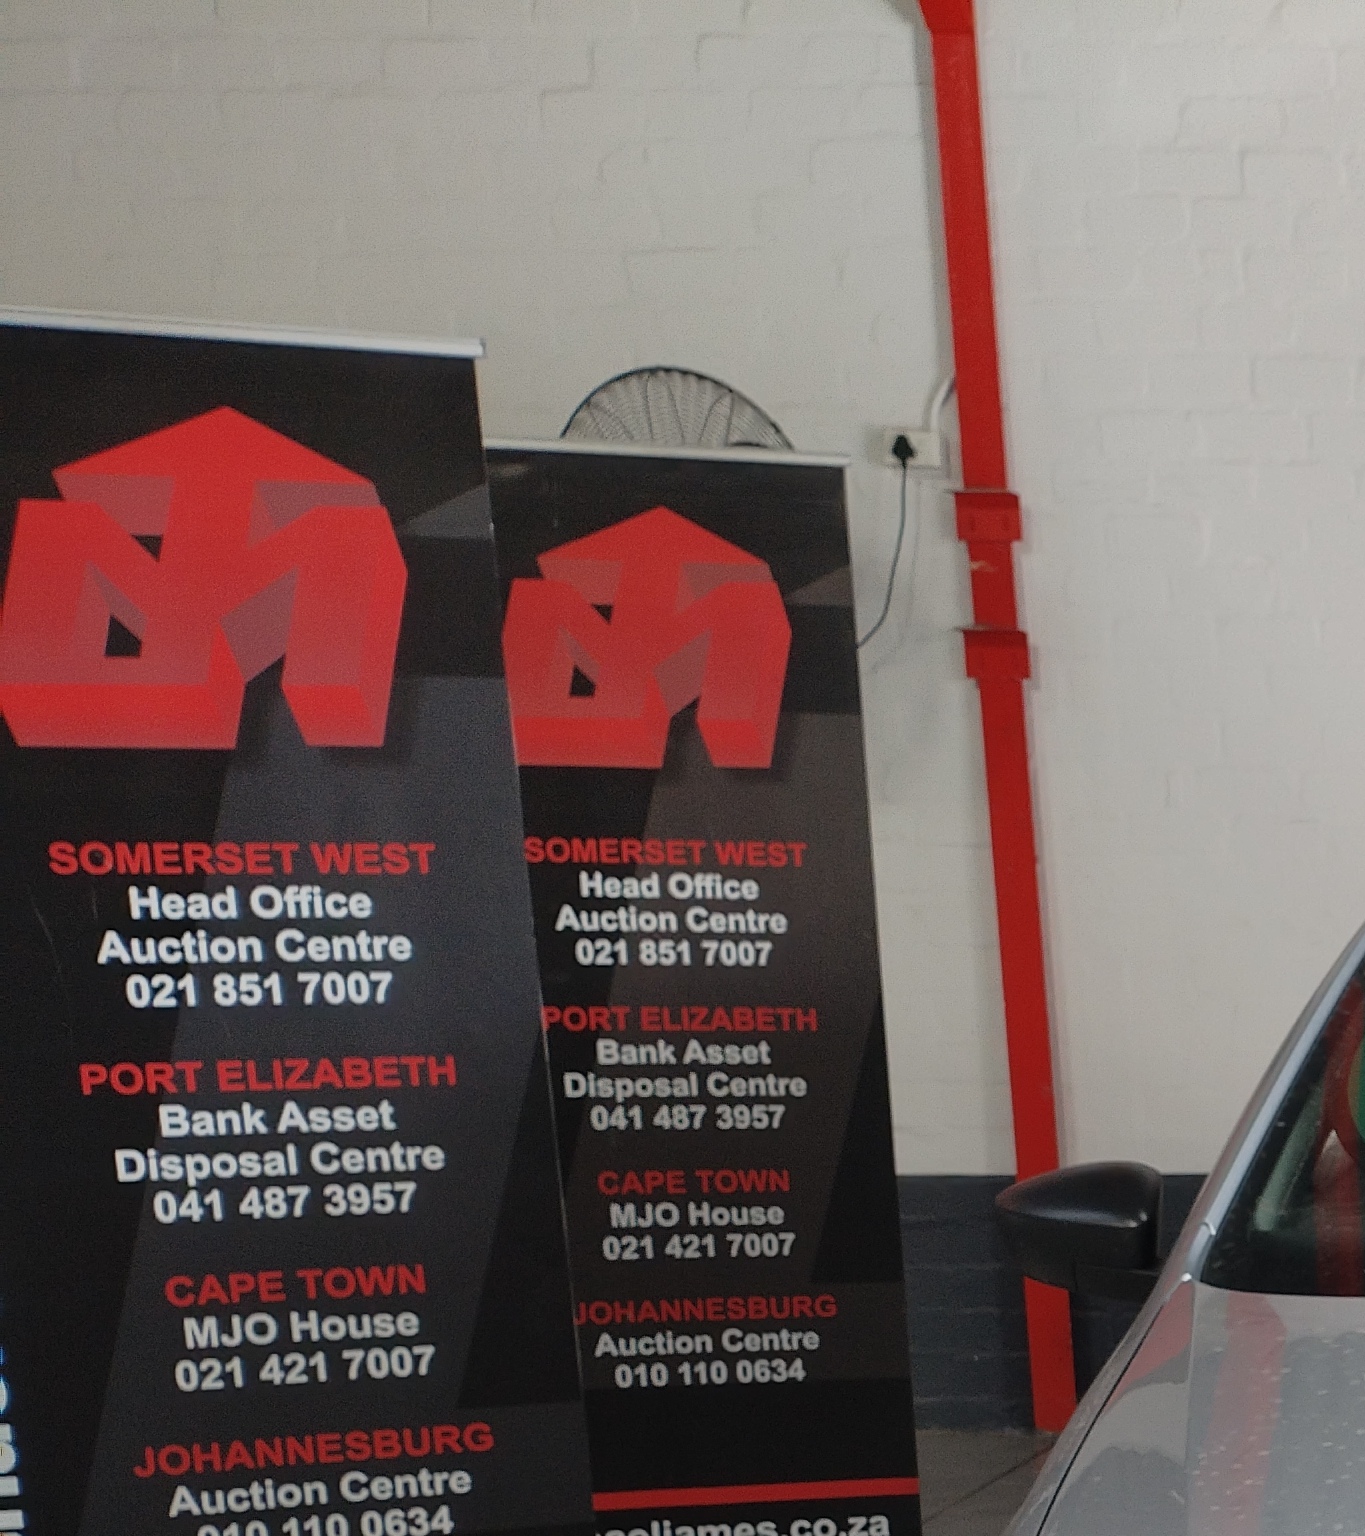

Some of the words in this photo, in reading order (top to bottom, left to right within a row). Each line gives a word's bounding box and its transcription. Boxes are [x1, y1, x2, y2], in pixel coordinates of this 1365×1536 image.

[48, 841, 298, 875] SOMERSET
[310, 843, 436, 874] WEST
[523, 837, 706, 865] SOMERSET
[715, 840, 808, 867] WEST
[579, 871, 659, 899] Head
[667, 873, 760, 900] Office
[129, 886, 237, 920] Head
[250, 887, 373, 919] Office
[555, 905, 678, 933] Auction
[685, 908, 788, 934] Centre
[97, 931, 263, 965] Auction
[276, 930, 413, 963] Centre
[575, 938, 630, 966] 021
[638, 940, 692, 966] 851
[701, 941, 773, 967] 7007
[126, 974, 196, 1009] 021
[213, 973, 284, 1007] 851
[298, 971, 393, 1005] 7007
[543, 1006, 629, 1032] PORT
[640, 1006, 819, 1032] ELIZABETH
[595, 1038, 677, 1066] Bank
[683, 1038, 772, 1066] Asset
[79, 1061, 203, 1095] PORT
[217, 1055, 457, 1092] ELIZABETH
[563, 1072, 699, 1102] Disposal
[706, 1073, 808, 1098] Centre
[158, 1102, 268, 1138] Bank
[277, 1100, 397, 1134] Asset
[590, 1105, 644, 1131] 041
[653, 1105, 707, 1130] 487
[715, 1104, 786, 1129] 3957
[115, 1145, 297, 1186] Disposal
[310, 1141, 445, 1174] Centre
[597, 1170, 687, 1195] CAPE
[697, 1170, 790, 1193] TOWN
[153, 1189, 223, 1224] 041
[239, 1185, 309, 1220] 487
[323, 1181, 417, 1215] 3957
[610, 1203, 680, 1229] MJO
[688, 1203, 785, 1227] House
[602, 1235, 654, 1262] 021
[665, 1234, 717, 1260] 421
[726, 1232, 797, 1259] 7007
[164, 1270, 285, 1308] CAPE
[297, 1264, 426, 1299] TOWN
[574, 1295, 838, 1327] JOHANNESBURG
[184, 1313, 276, 1350] MJO
[290, 1311, 419, 1344] House
[594, 1331, 713, 1359] Auction
[721, 1328, 820, 1353] Centre
[174, 1355, 245, 1392] 021
[259, 1351, 330, 1388] 421
[343, 1345, 437, 1383] 7007
[614, 1362, 668, 1389] 010
[677, 1360, 729, 1387] 110
[736, 1358, 807, 1384] 0634
[133, 1422, 495, 1479] JOHANNESBURG
[168, 1470, 329, 1518] Auction
[339, 1465, 473, 1501] Centre
